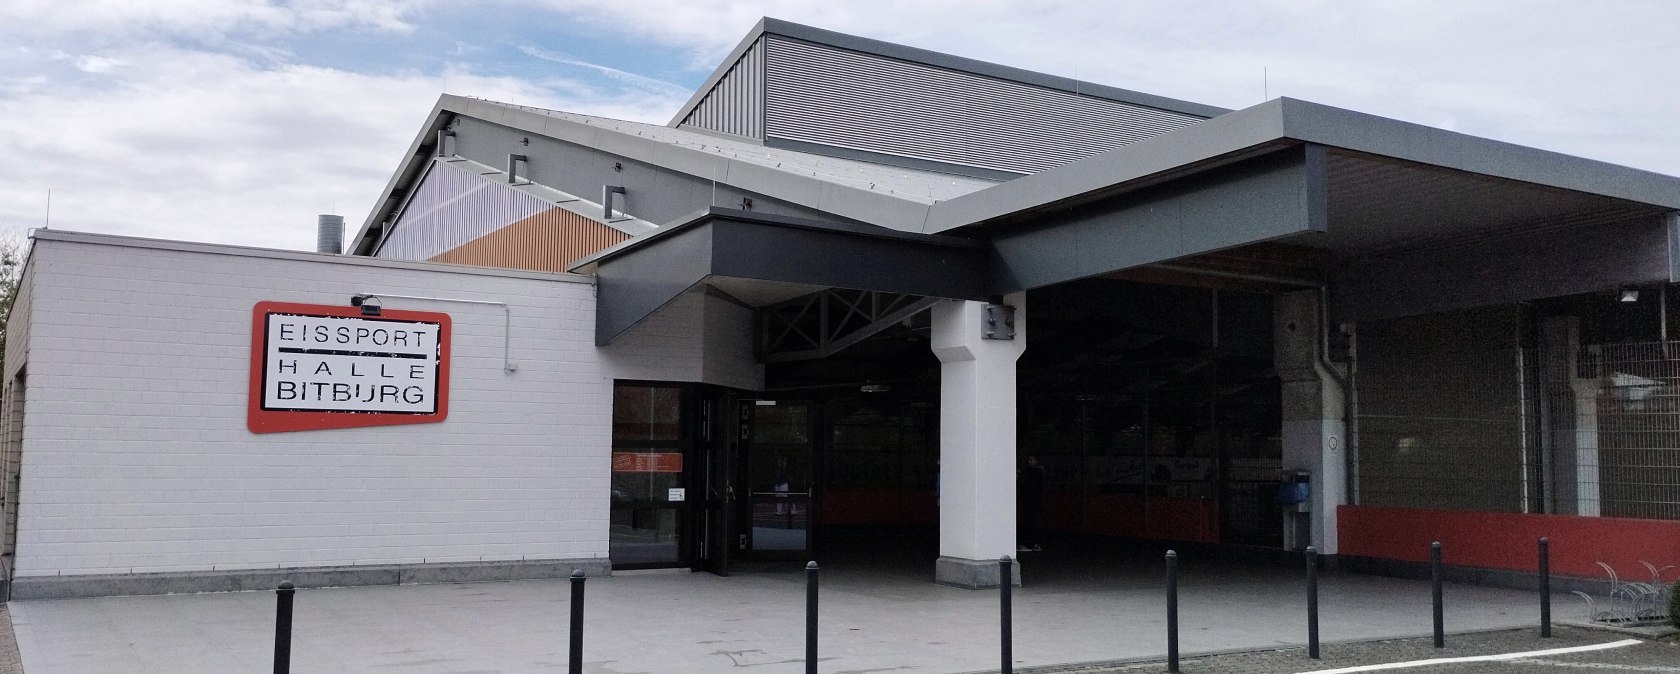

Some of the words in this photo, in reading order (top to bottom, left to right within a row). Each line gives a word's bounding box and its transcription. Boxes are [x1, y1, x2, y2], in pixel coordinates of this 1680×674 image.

[279, 323, 426, 347] EISSPORT
[278, 359, 425, 380] HALLE
[276, 381, 424, 405] BITBURG
